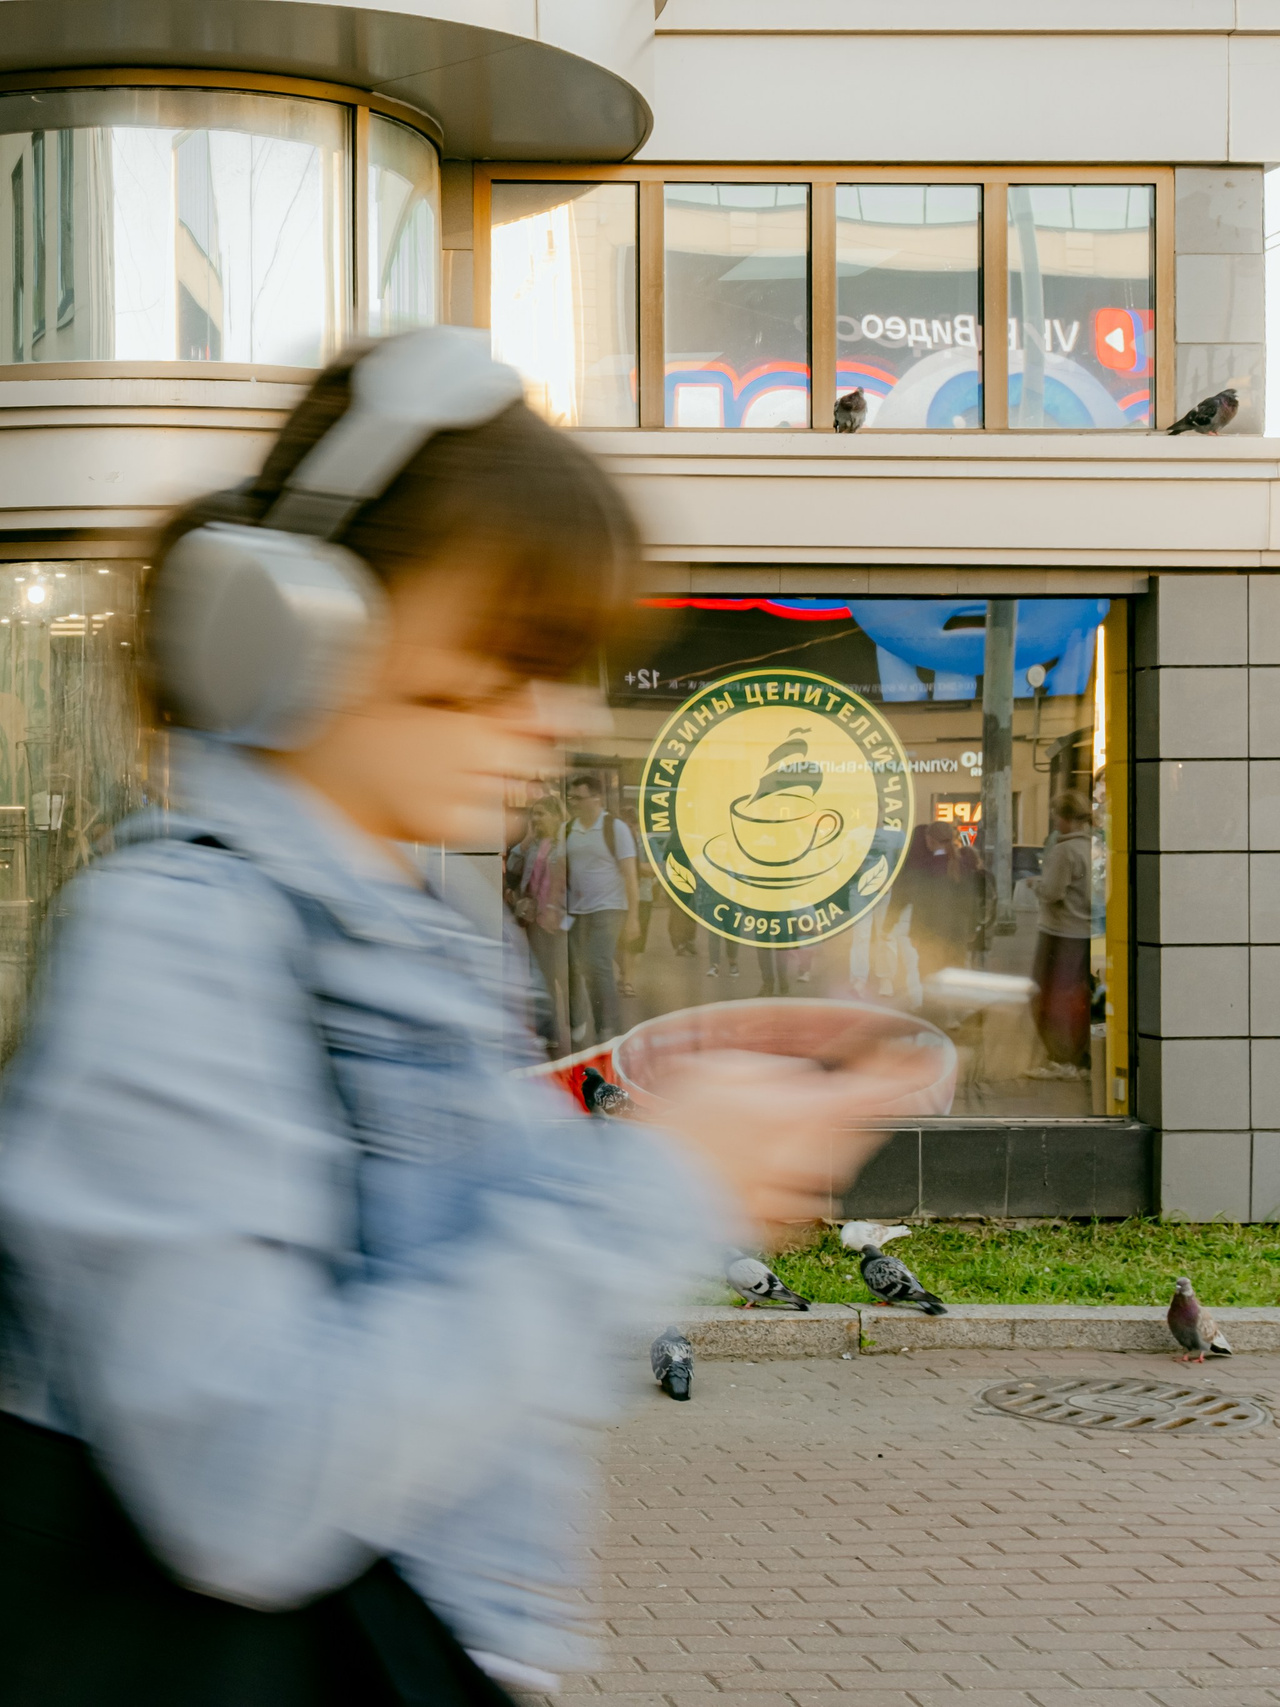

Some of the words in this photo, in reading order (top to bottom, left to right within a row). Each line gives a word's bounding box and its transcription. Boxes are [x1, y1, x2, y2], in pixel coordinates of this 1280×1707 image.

[651, 691, 735, 832] МАГАЗИНЫ
[745, 681, 894, 763] ЦЕНИТЕЛЕЙ
[883, 776, 903, 832] ЧАЯ
[713, 903, 730, 922] С
[733, 912, 781, 936] 1995
[787, 901, 844, 935] ГОДА
